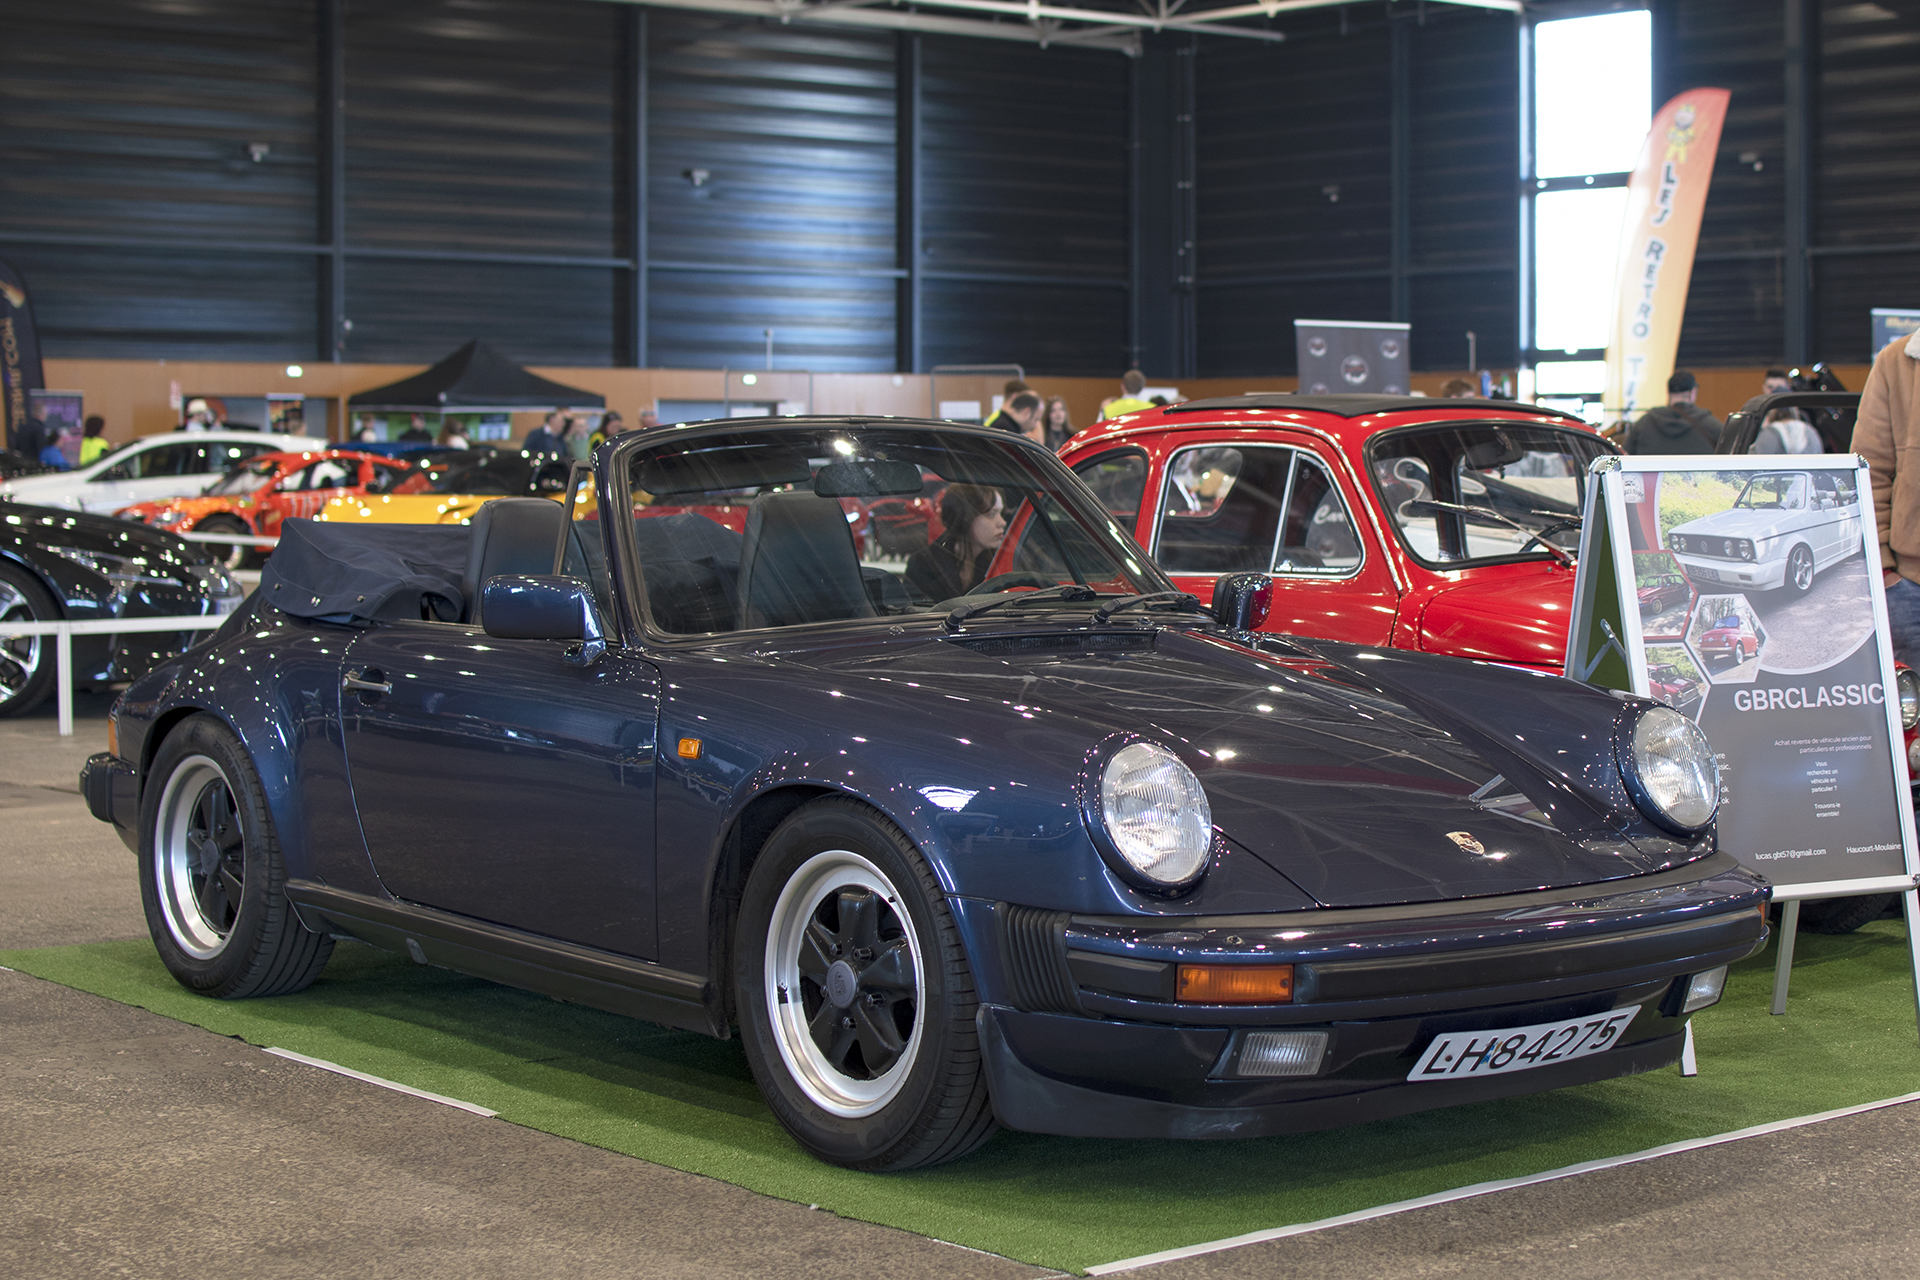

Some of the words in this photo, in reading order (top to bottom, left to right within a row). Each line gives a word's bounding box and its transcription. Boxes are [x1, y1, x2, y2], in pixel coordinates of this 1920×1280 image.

[1632, 239, 1665, 339] RETRO
[1734, 683, 1885, 711] GBRCLASSIC
[1799, 746, 1829, 754] particuliers
[1835, 743, 1872, 752] professionnels
[1846, 843, 1901, 853] Haucourt-Moulaine
